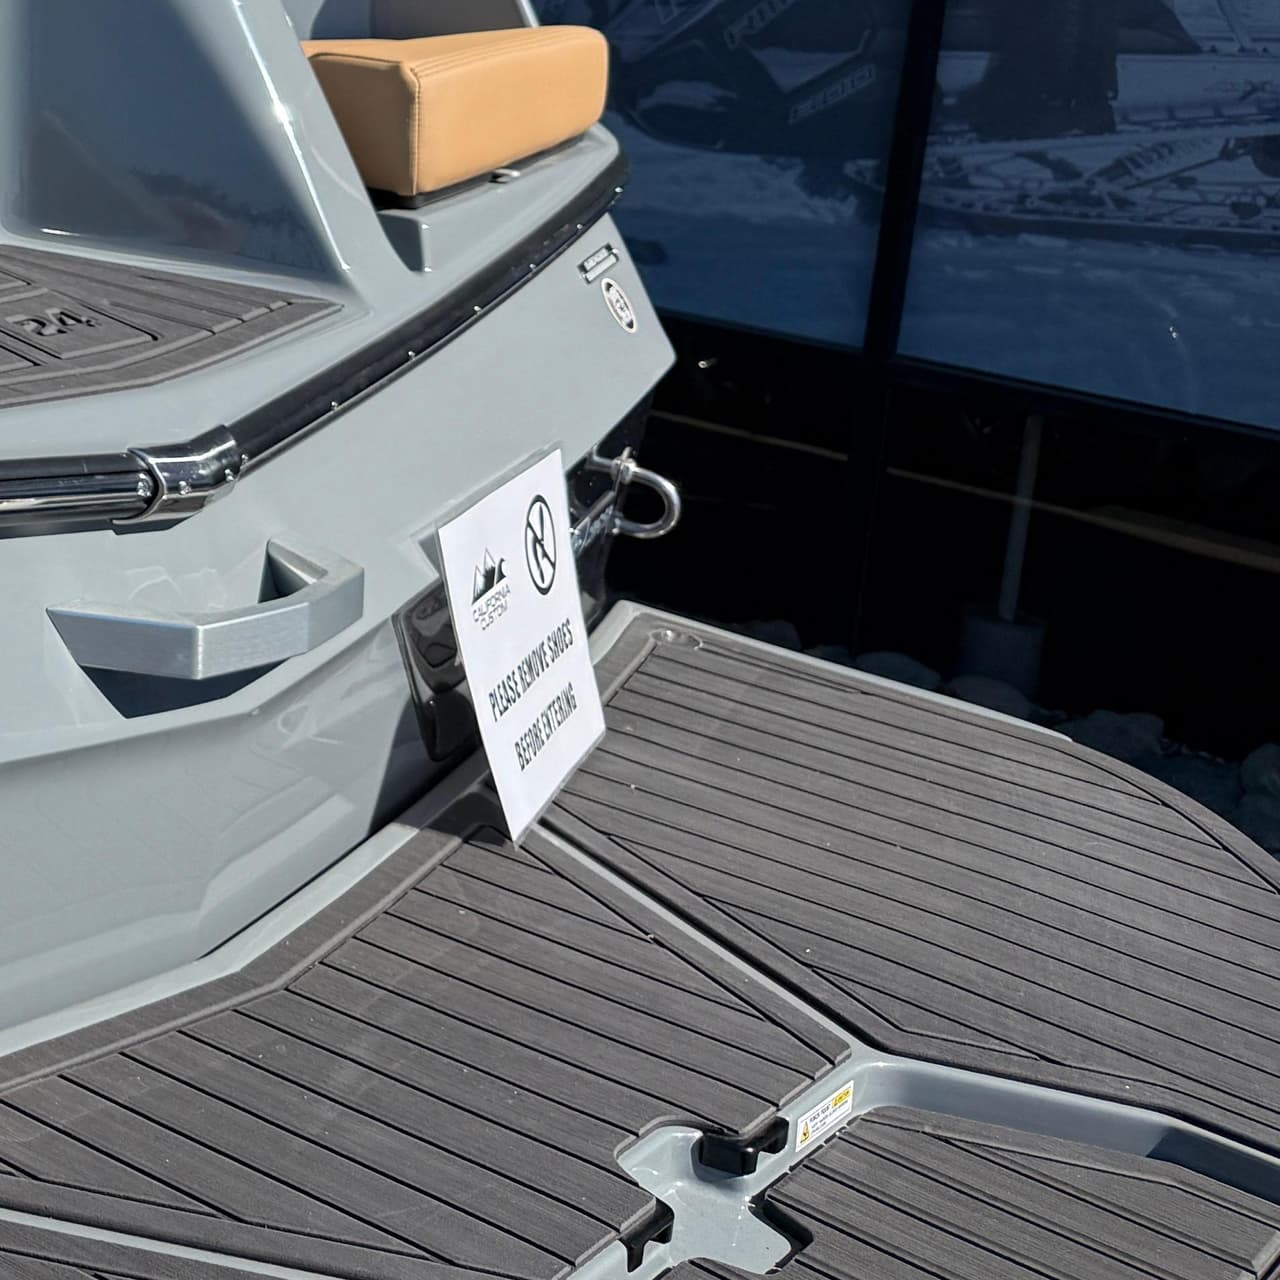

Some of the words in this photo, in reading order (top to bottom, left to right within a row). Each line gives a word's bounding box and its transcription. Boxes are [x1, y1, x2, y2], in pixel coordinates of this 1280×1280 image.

[5, 307, 101, 336] 24
[473, 584, 511, 622] CALIFORNIA
[480, 600, 507, 630] CUSTOM
[488, 670, 521, 722] PLEASE
[518, 640, 549, 693] REMOVE
[546, 618, 574, 663] SHOES
[514, 717, 545, 771] BEFORE
[541, 682, 578, 741] ENTERING
